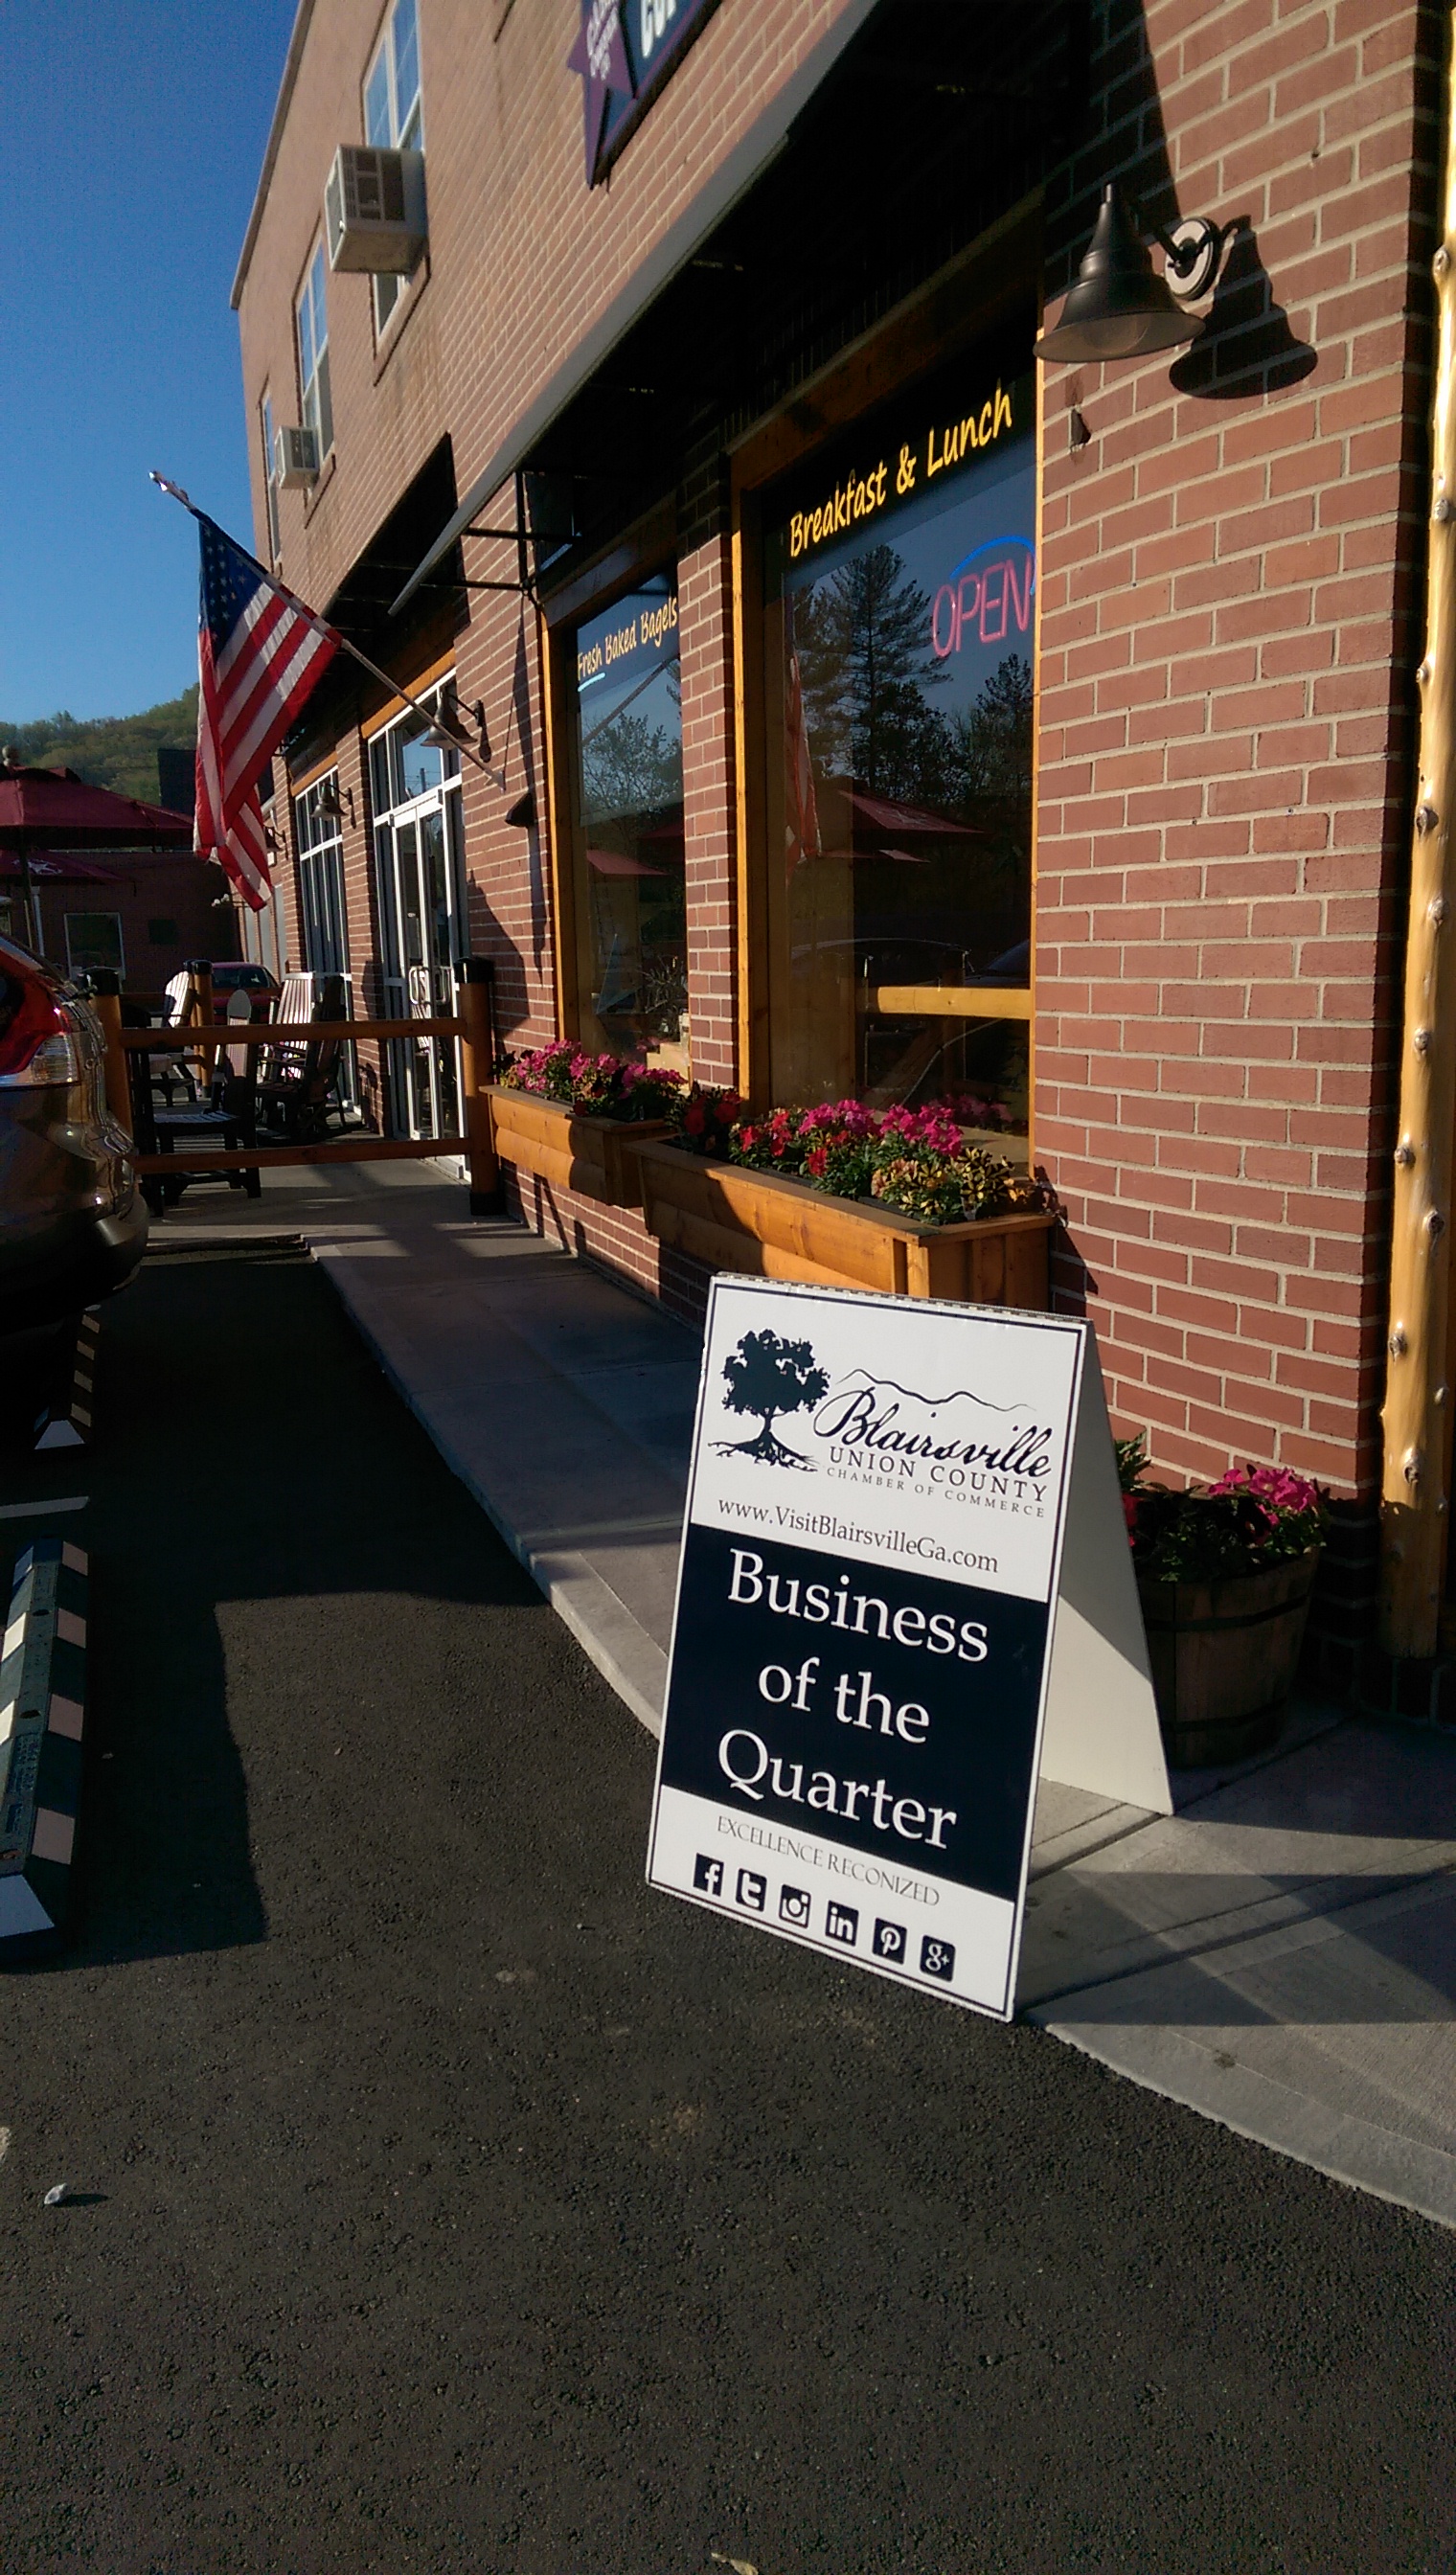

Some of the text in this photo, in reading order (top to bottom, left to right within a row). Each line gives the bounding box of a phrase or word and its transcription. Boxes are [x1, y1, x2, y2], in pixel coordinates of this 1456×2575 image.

[790, 378, 1012, 557] Breakfast & Lunch
[578, 596, 677, 681] Fresh Baked Bagels
[932, 553, 1032, 657] OPEN
[813, 1386, 1053, 1477] Blairsville
[830, 1446, 1047, 1502] UNION COUNTY
[718, 1498, 999, 1574] www.VisitBlairsvilleGa.com
[827, 1467, 1044, 1518] CHAMBER OF COMMERCE
[728, 1547, 989, 1663] Business
[759, 1656, 930, 1743] of the
[718, 1729, 957, 1850] Quarter
[717, 1815, 940, 1906] EXCELLENCE RECONIZED
